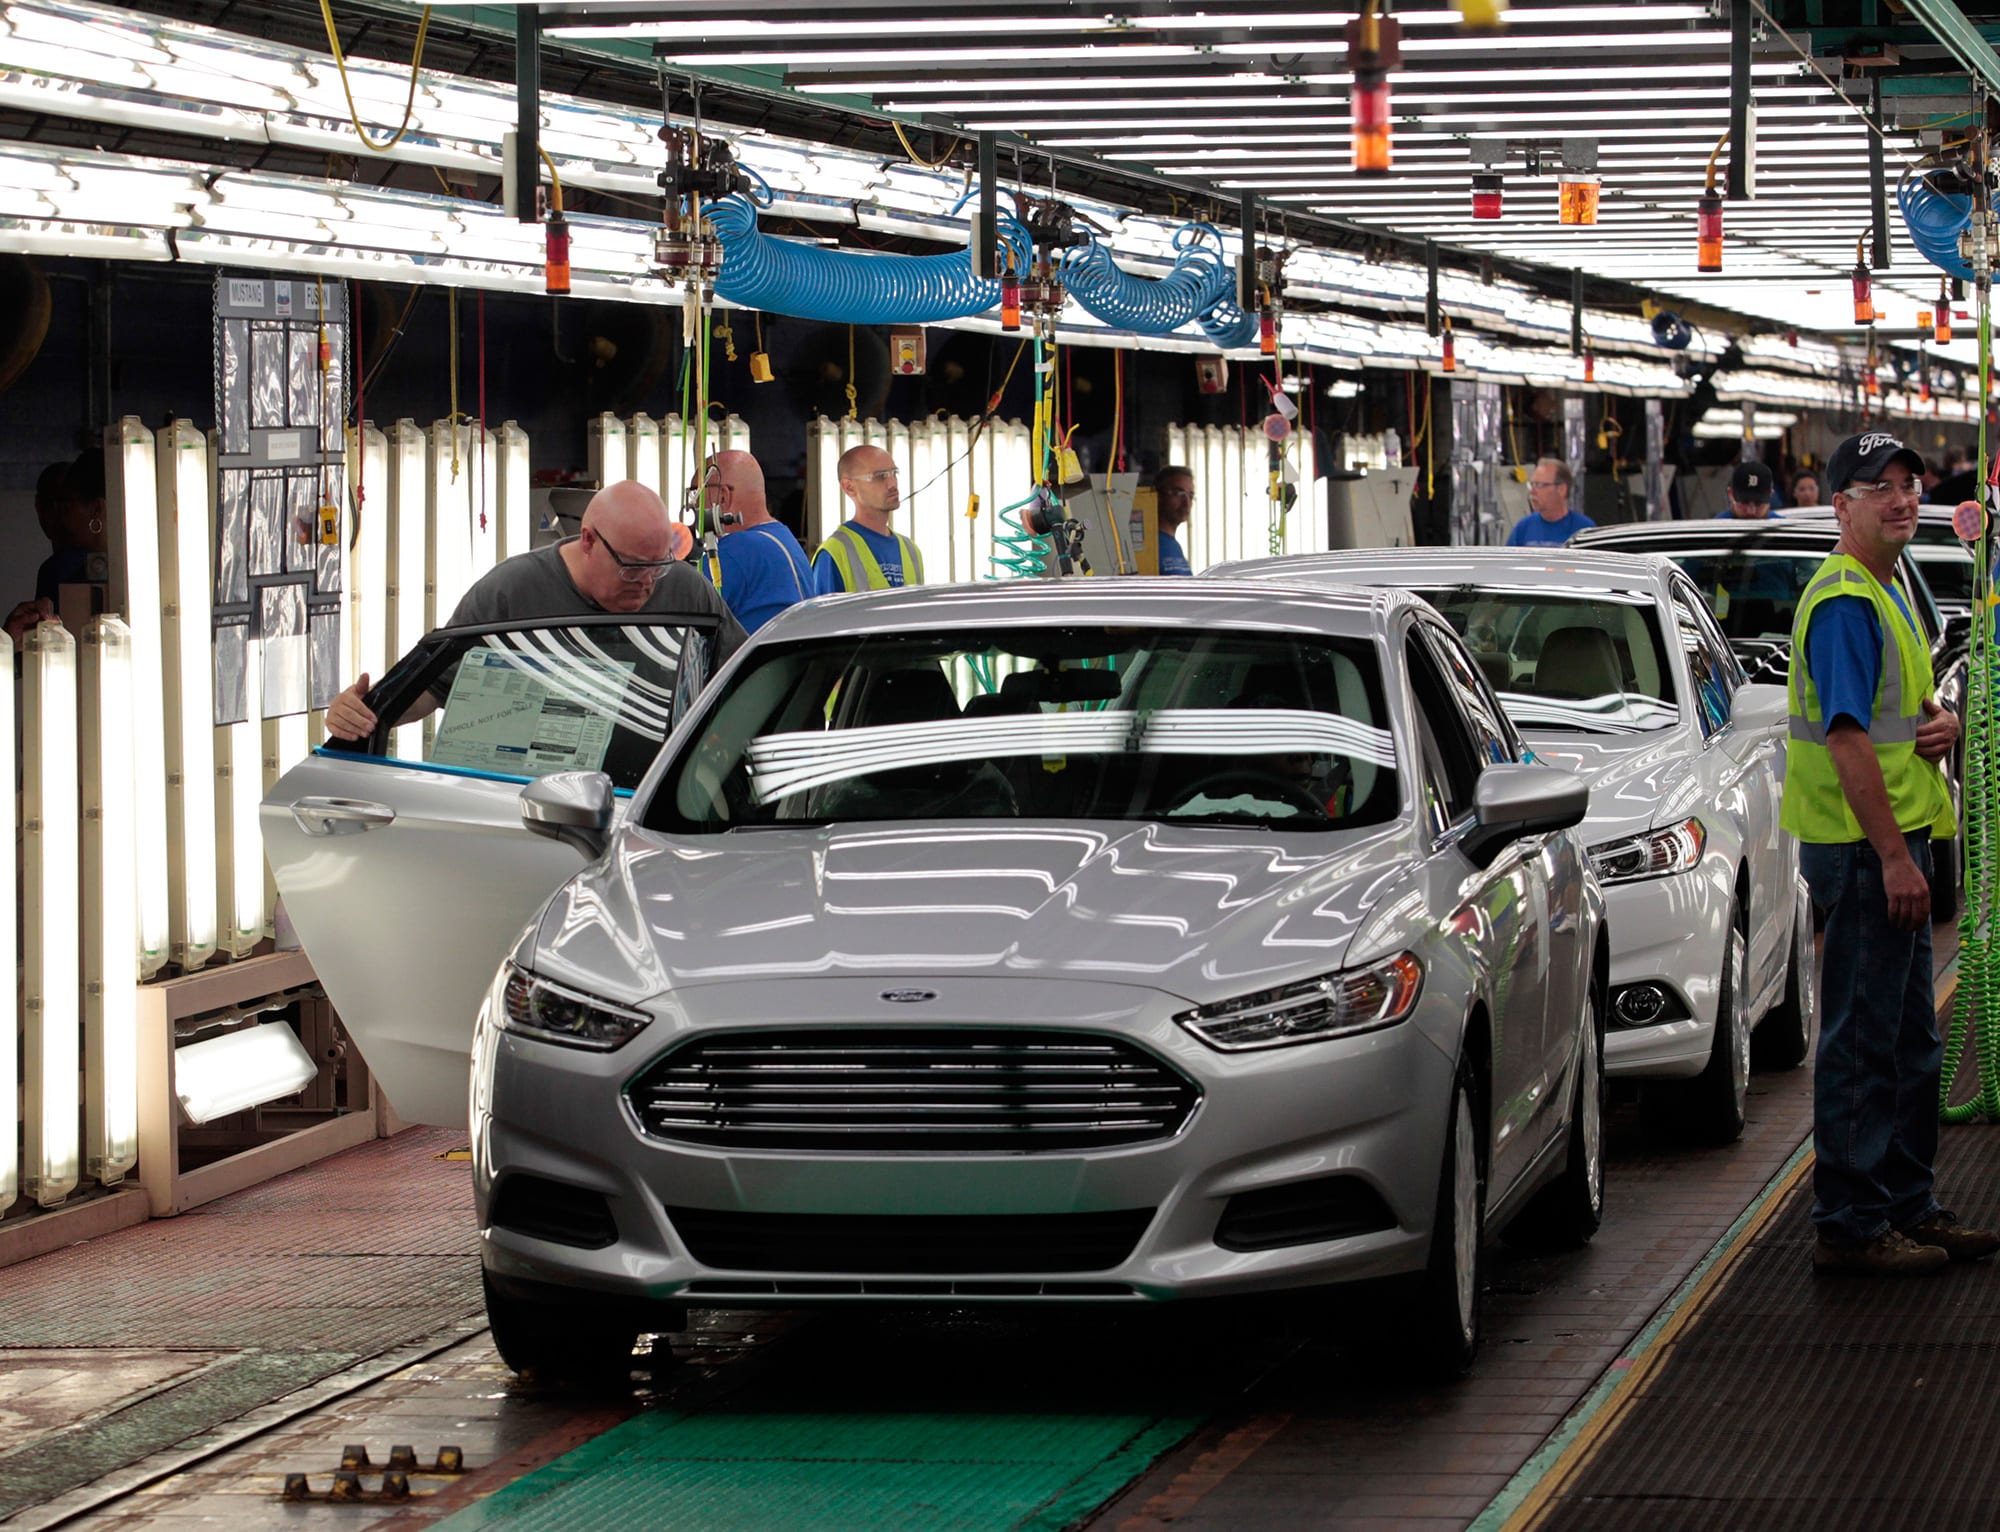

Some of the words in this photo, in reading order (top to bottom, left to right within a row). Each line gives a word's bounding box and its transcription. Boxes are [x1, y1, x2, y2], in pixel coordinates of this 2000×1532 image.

[231, 283, 261, 303] MUSTANG
[307, 287, 329, 305] FUSN
[1858, 433, 1904, 456] Ford
[444, 721, 474, 734] VEHICLE
[478, 714, 494, 724] NOT
[497, 709, 512, 719] FOR
